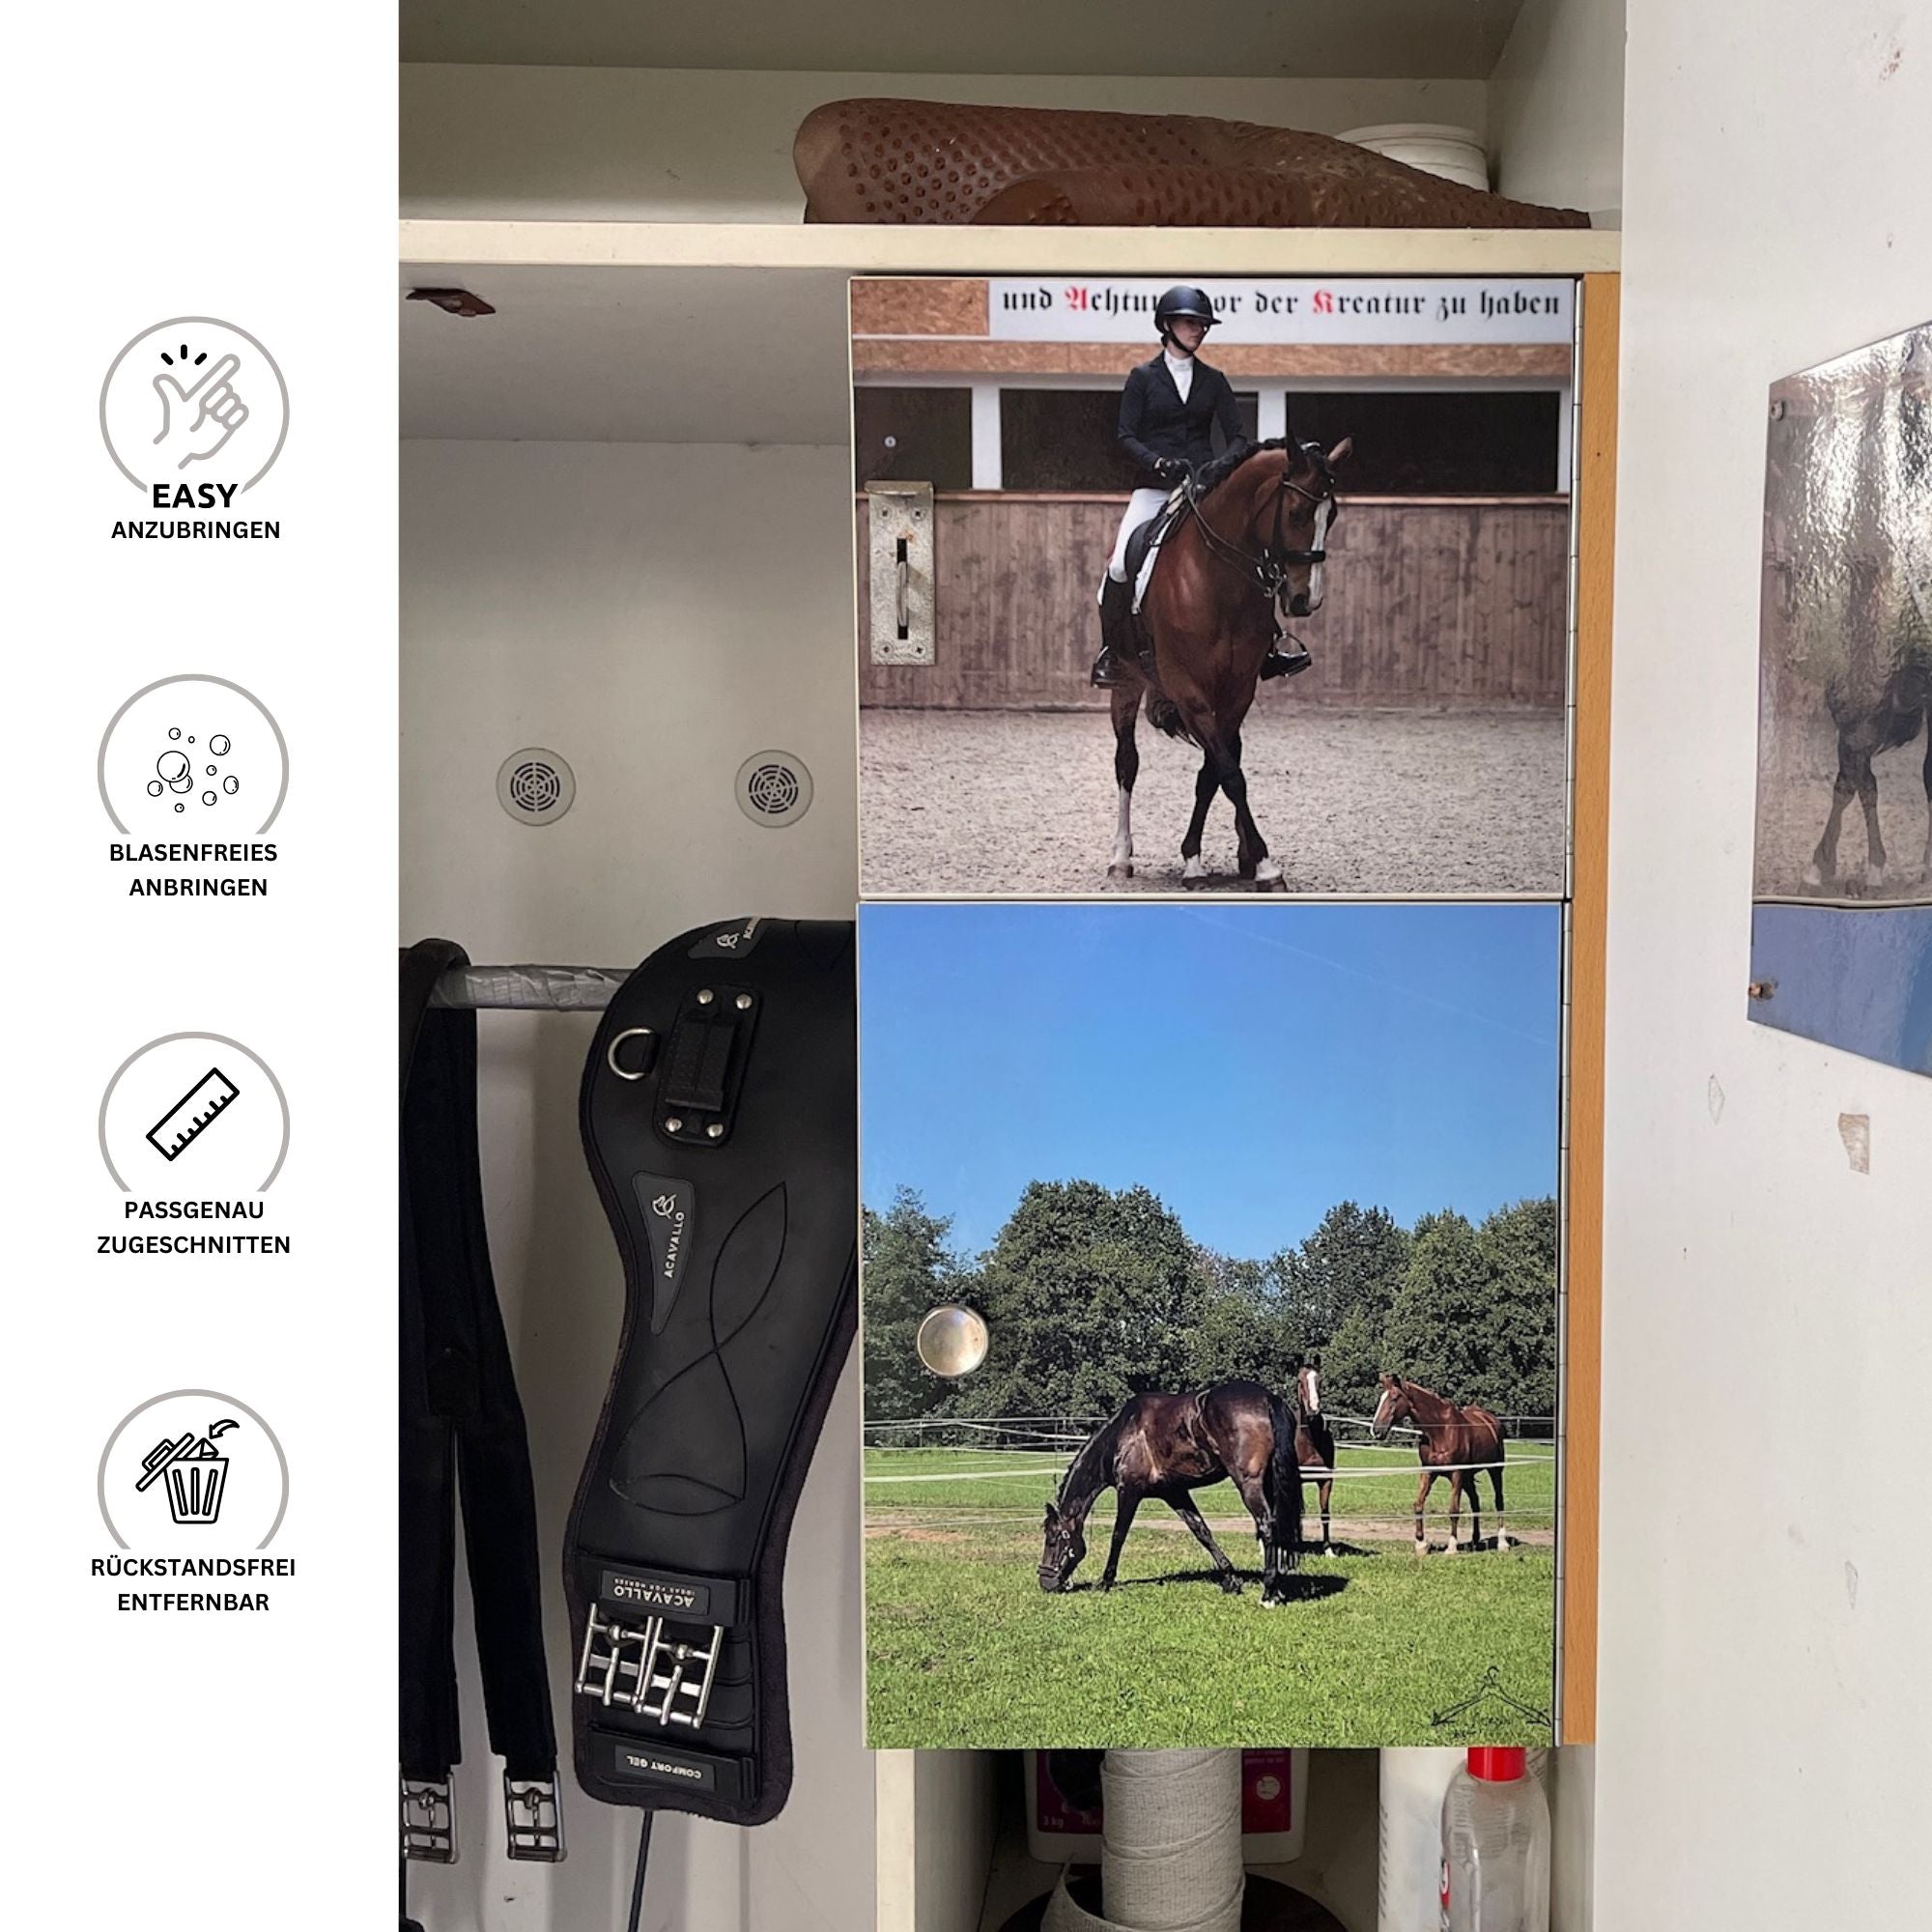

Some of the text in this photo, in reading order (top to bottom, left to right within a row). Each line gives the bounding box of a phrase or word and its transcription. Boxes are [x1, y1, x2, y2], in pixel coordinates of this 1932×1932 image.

[1002, 286, 1053, 310] und
[1065, 286, 1157, 316] Achtu
[1256, 289, 1299, 314] der
[1313, 289, 1427, 315] Kreatur
[1435, 294, 1466, 322] zu
[1480, 290, 1559, 320] haben
[663, 1211, 685, 1279] ACAVALLO
[613, 1585, 695, 1607] ACAVALLO
[626, 1755, 702, 1779] COMFORT GEL
